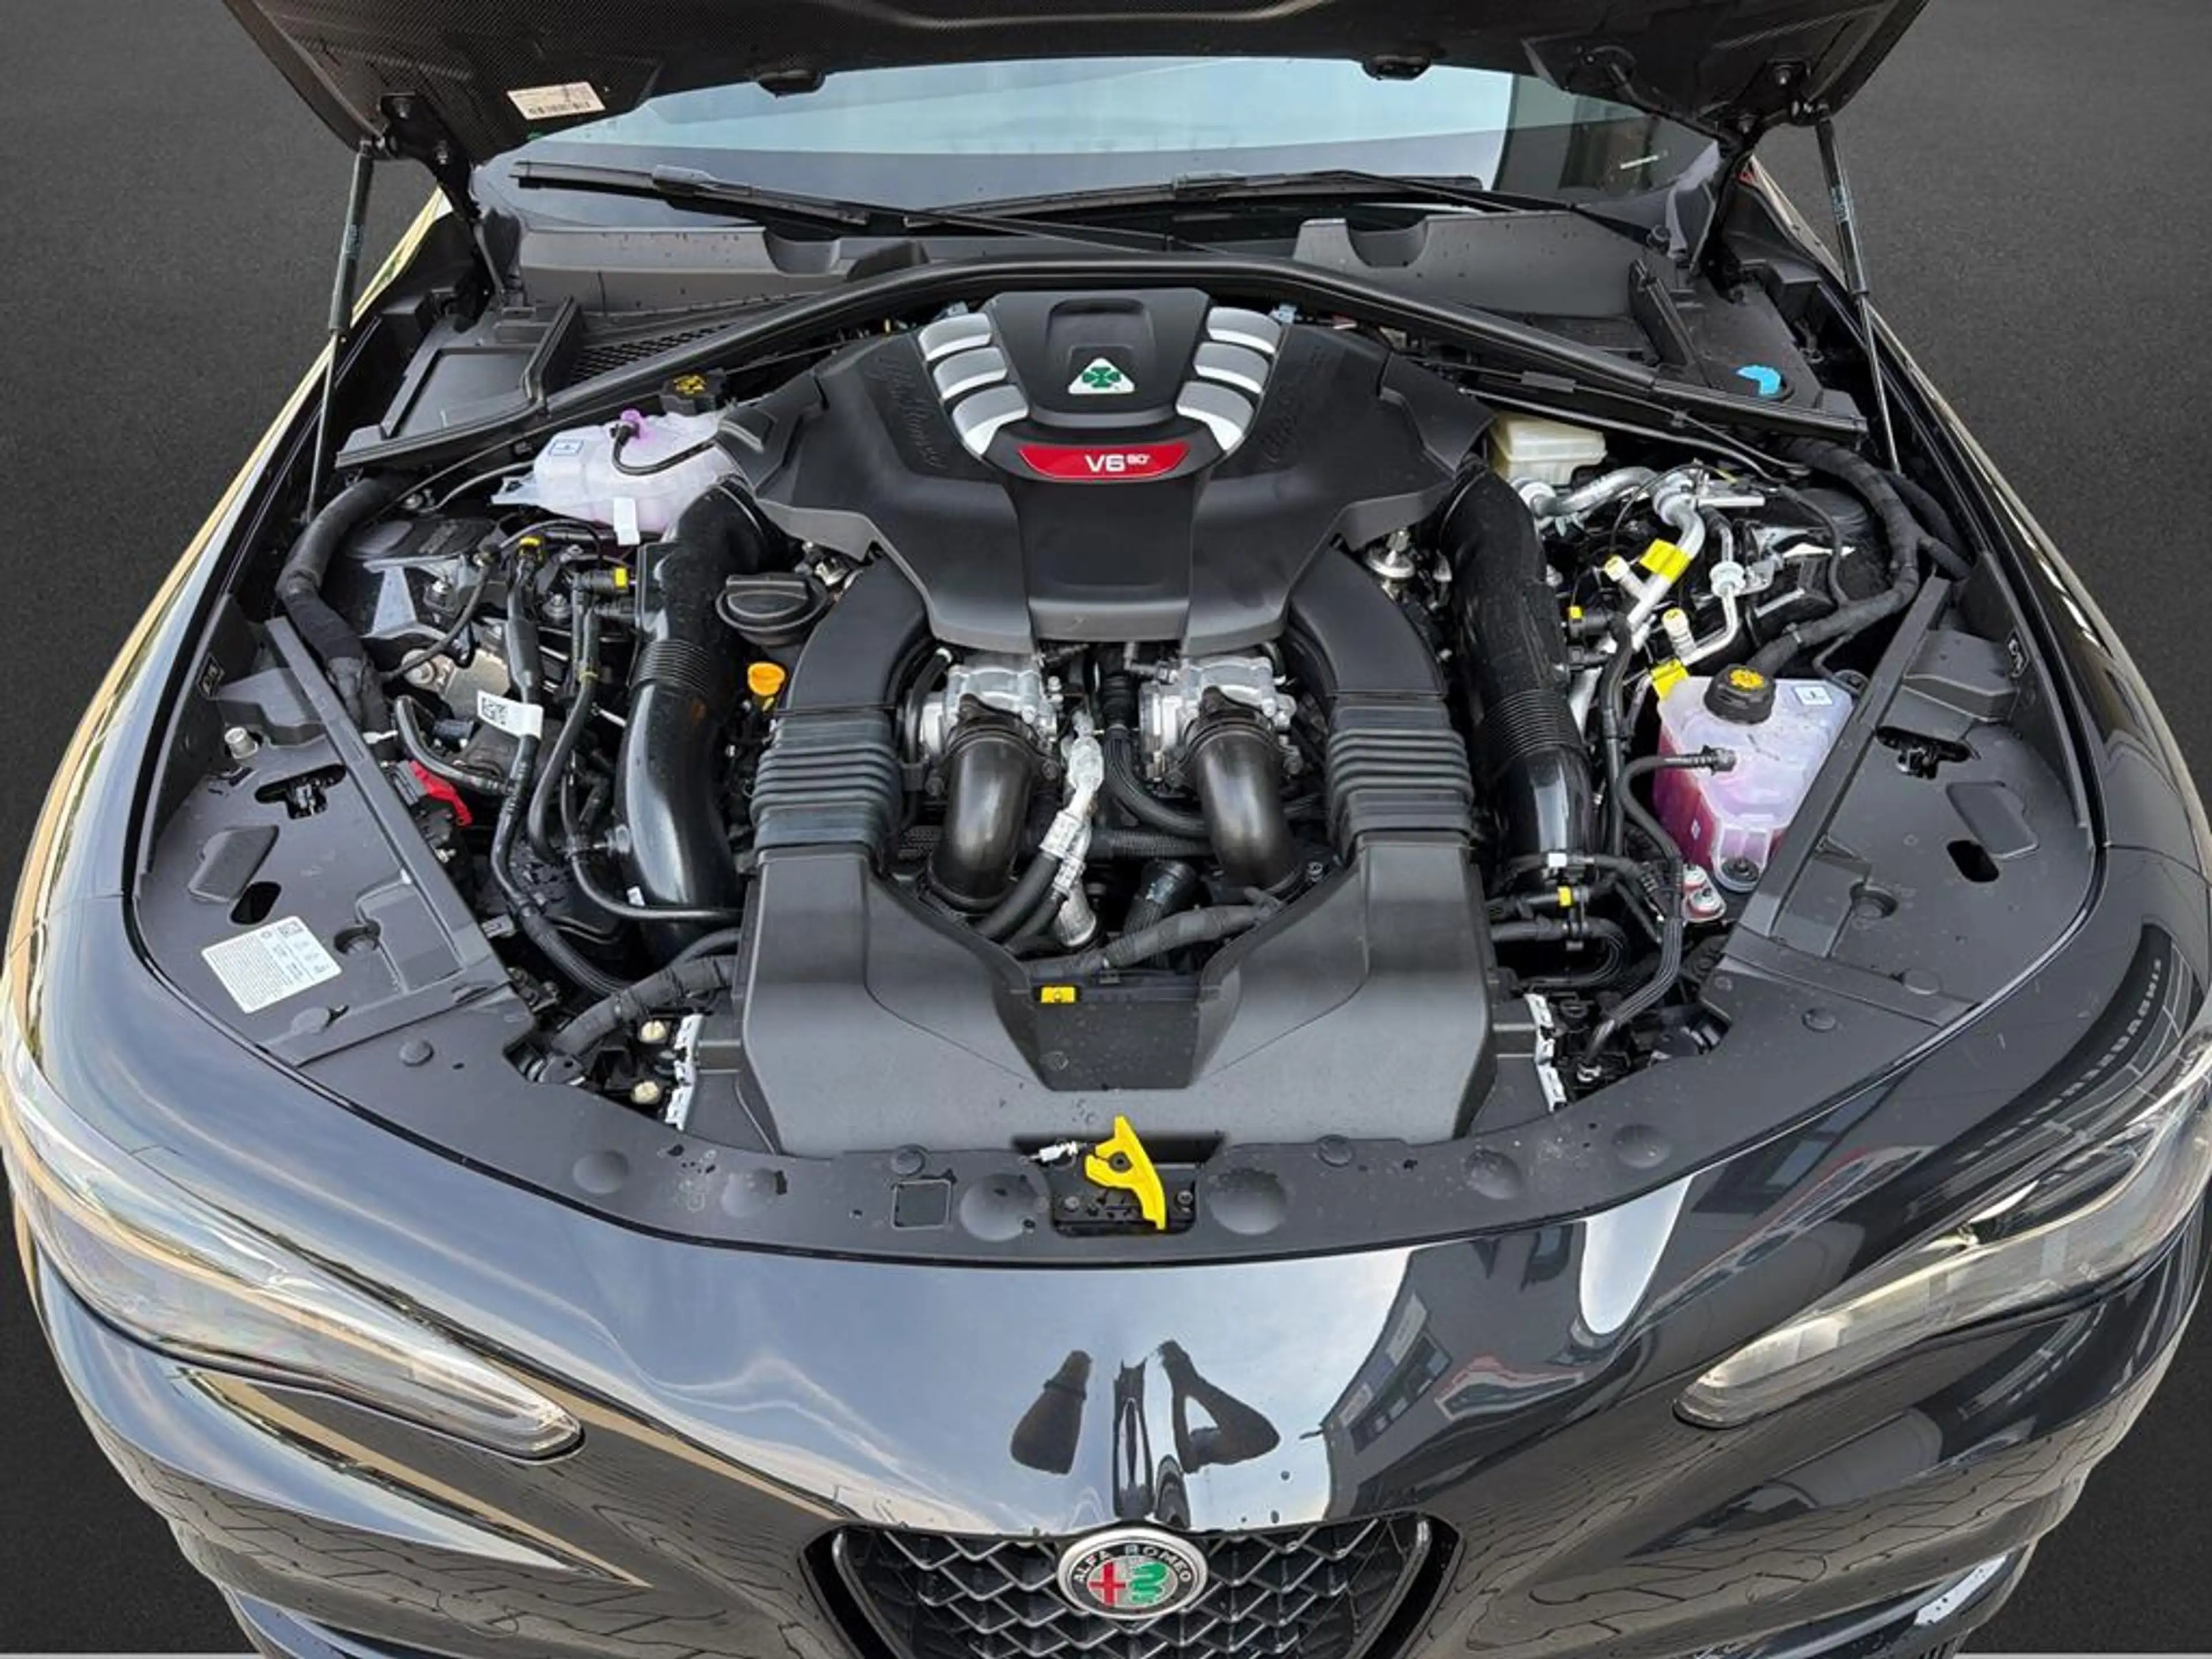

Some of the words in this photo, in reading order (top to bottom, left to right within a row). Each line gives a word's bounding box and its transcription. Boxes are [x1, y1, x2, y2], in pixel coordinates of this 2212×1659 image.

[1085, 454, 1126, 472] V6
[1073, 1550, 1113, 1583] ALFA
[1125, 1544, 1192, 1583] ROMEO
